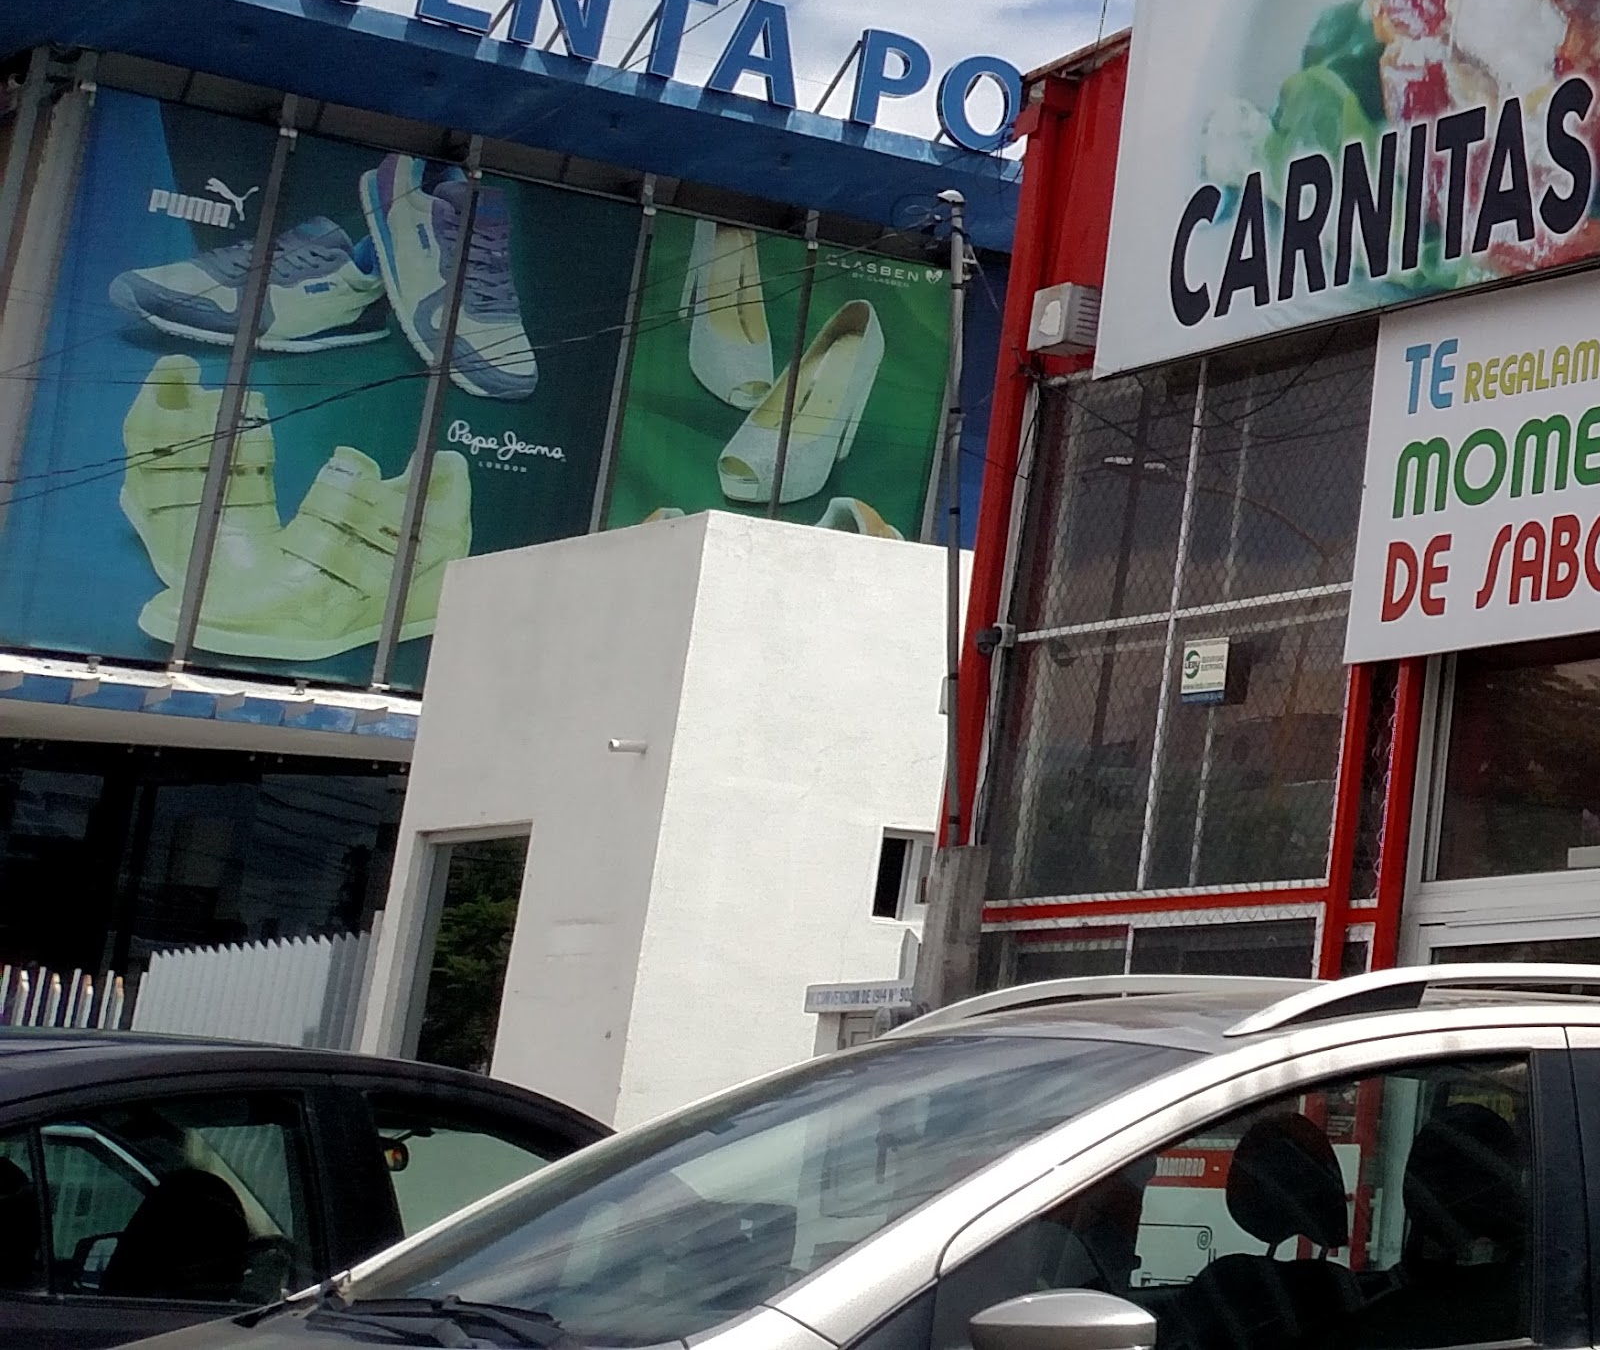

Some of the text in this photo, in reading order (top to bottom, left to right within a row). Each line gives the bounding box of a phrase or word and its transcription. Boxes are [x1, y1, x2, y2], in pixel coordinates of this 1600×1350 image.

[848, 27, 1022, 153] PO
[148, 188, 232, 228] PUMA
[1169, 76, 1594, 328] CARNITAS
[825, 253, 919, 282] CLASBEN
[1404, 338, 1459, 415] TE
[447, 419, 564, 461] Pepe Jeans
[478, 461, 528, 473] LONDON
[1380, 533, 1453, 624] DE
[1184, 660, 1200, 669] LEDU
